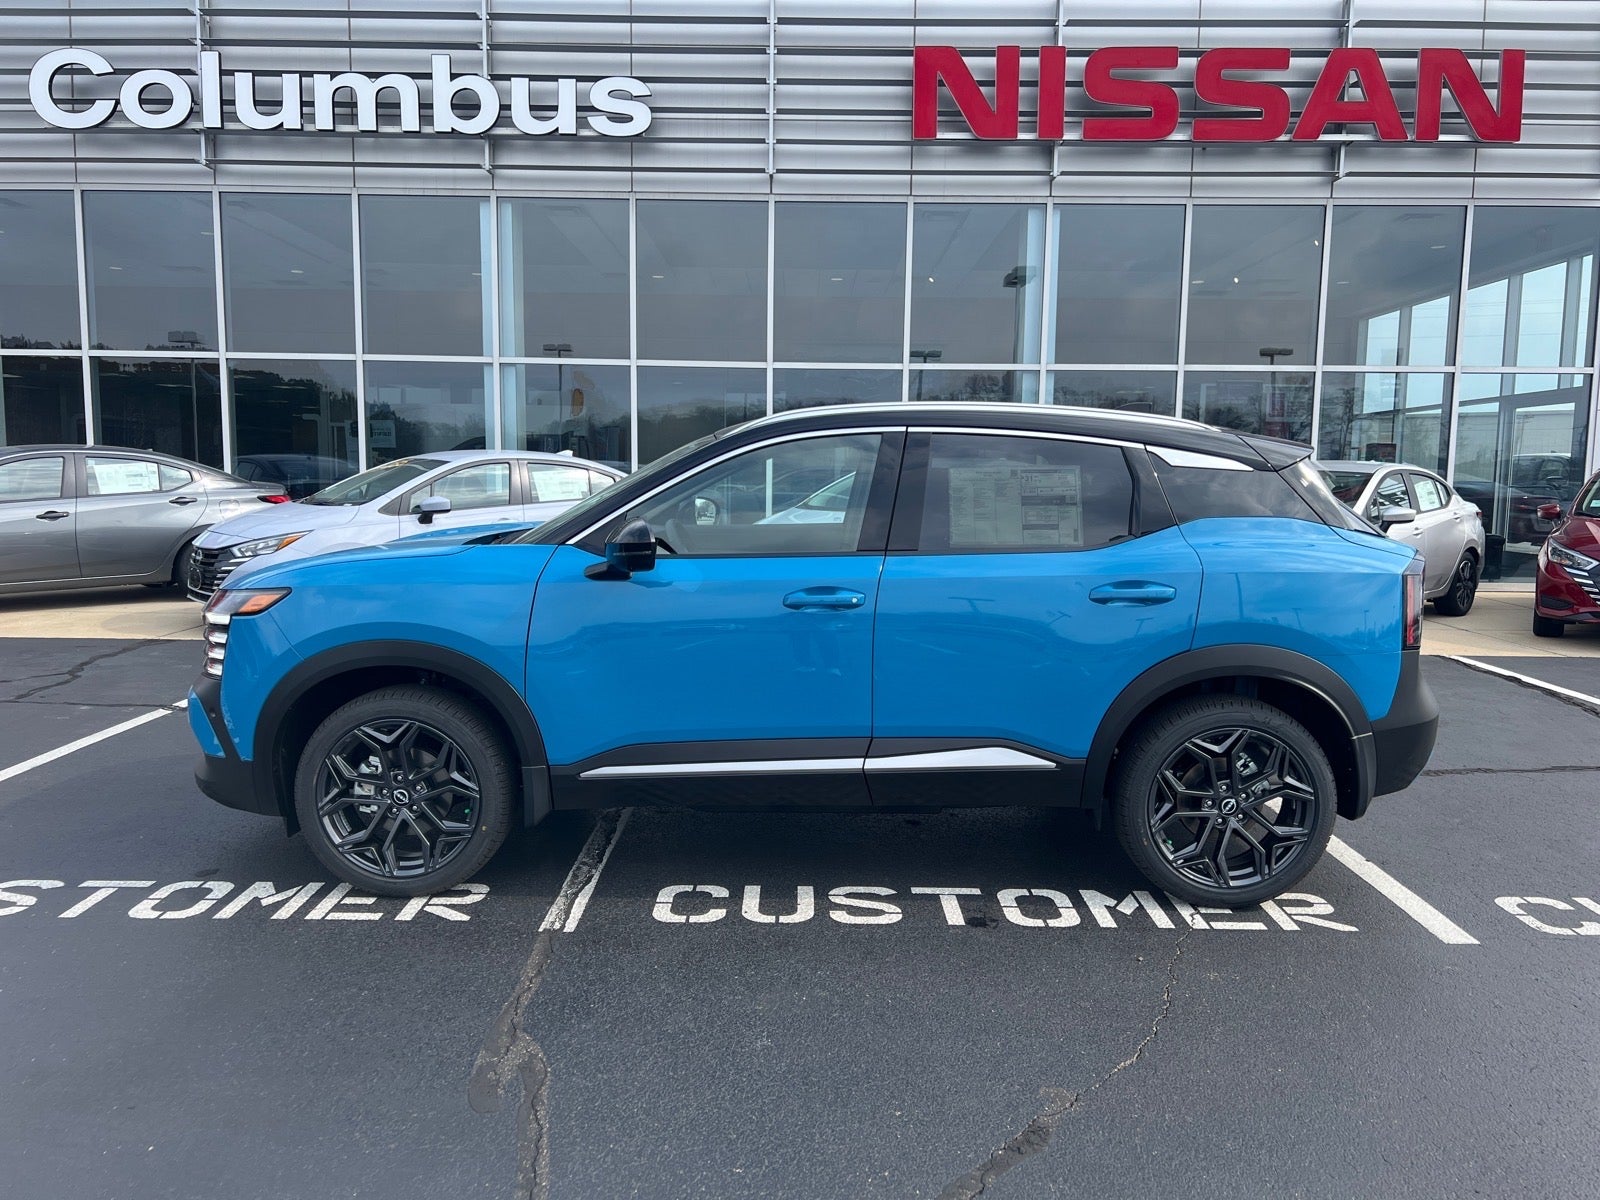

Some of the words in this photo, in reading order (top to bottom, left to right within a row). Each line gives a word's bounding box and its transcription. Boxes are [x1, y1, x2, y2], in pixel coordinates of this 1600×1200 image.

[28, 47, 653, 138] Columbus
[912, 45, 1525, 144] NISSAN
[652, 884, 1359, 932] CUSTOMER
